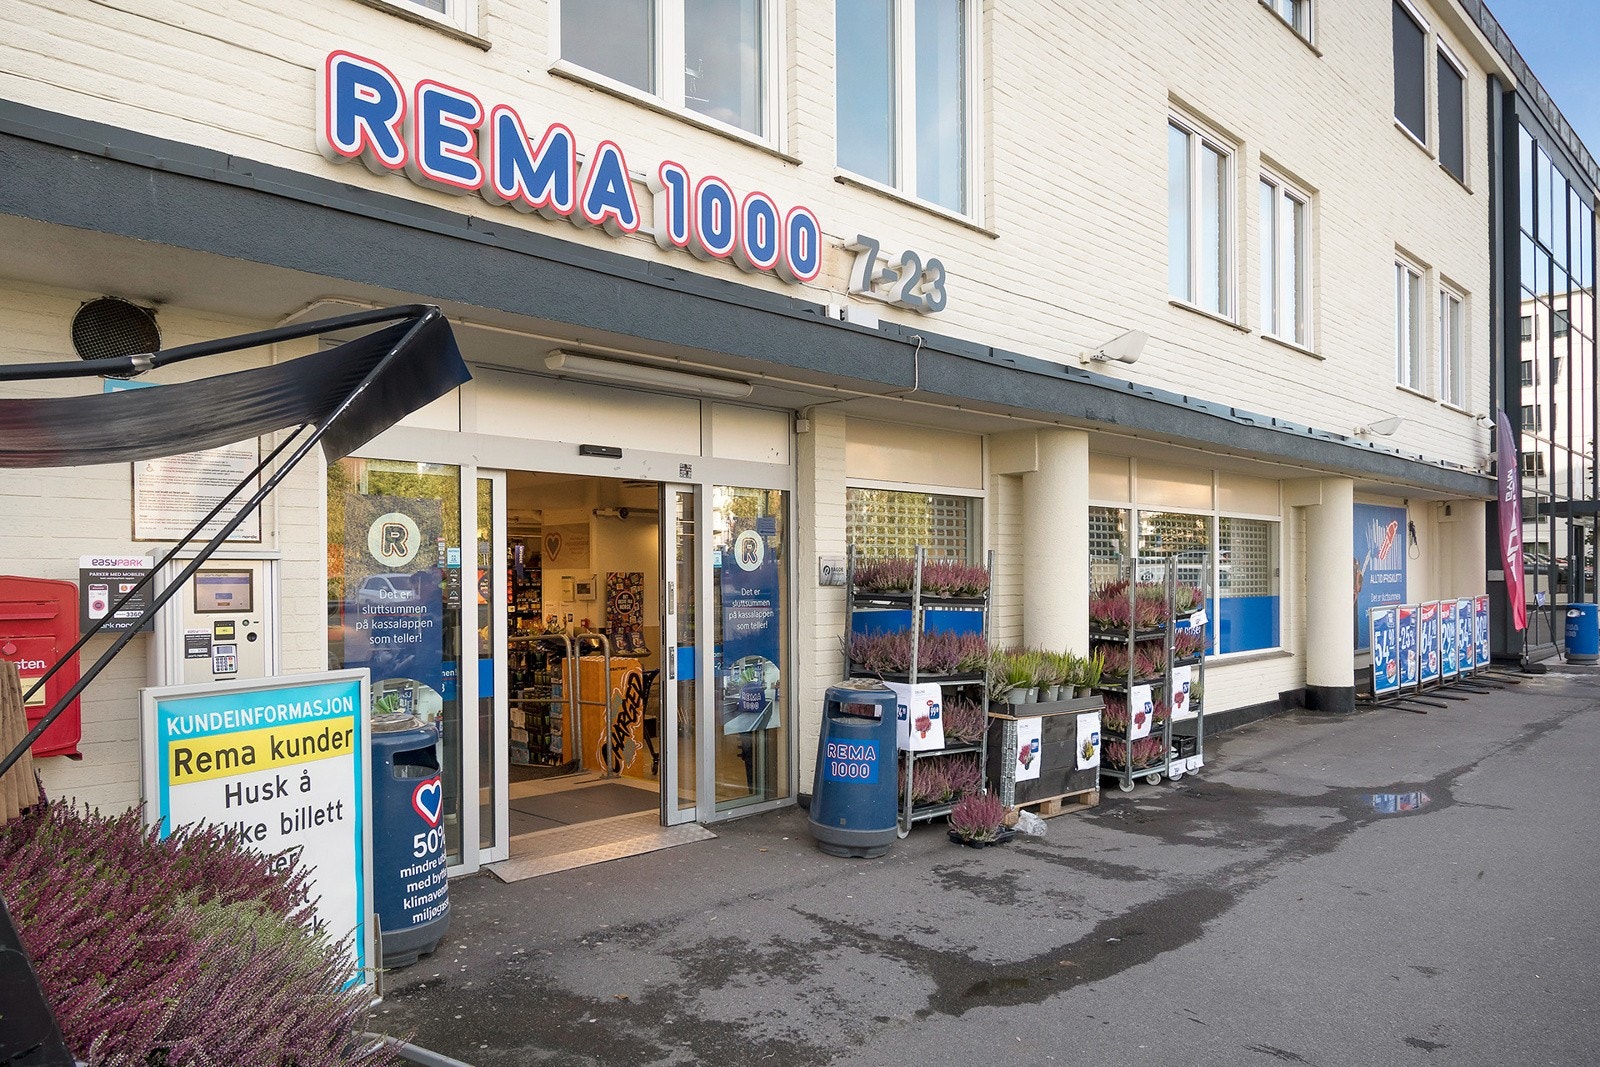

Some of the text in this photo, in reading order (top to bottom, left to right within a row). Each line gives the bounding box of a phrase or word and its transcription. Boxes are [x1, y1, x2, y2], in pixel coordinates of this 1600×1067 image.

[325, 50, 822, 282] REMA 1000
[856, 234, 947, 312] 7-23
[381, 523, 408, 557] R
[742, 537, 758, 564] R
[380, 589, 411, 599] Det er
[741, 588, 753, 596] Det
[362, 604, 427, 614] sluttsummen
[732, 599, 771, 608] sluttsummen
[729, 610, 775, 620] på kassalappen
[356, 618, 433, 631] på kassalappen
[750, 620, 769, 630] teller!
[370, 632, 422, 645] som teller!
[14, 659, 45, 670] sten
[167, 696, 353, 736] KUNDEINFORMASJON
[174, 727, 353, 777] Rema kunder
[827, 743, 876, 761] REMA
[831, 761, 870, 778] 1000
[225, 769, 311, 808] Husk å
[280, 799, 343, 836] billett
[413, 825, 446, 858] 50%
[400, 860, 437, 879] mindre
[407, 875, 431, 893] med
